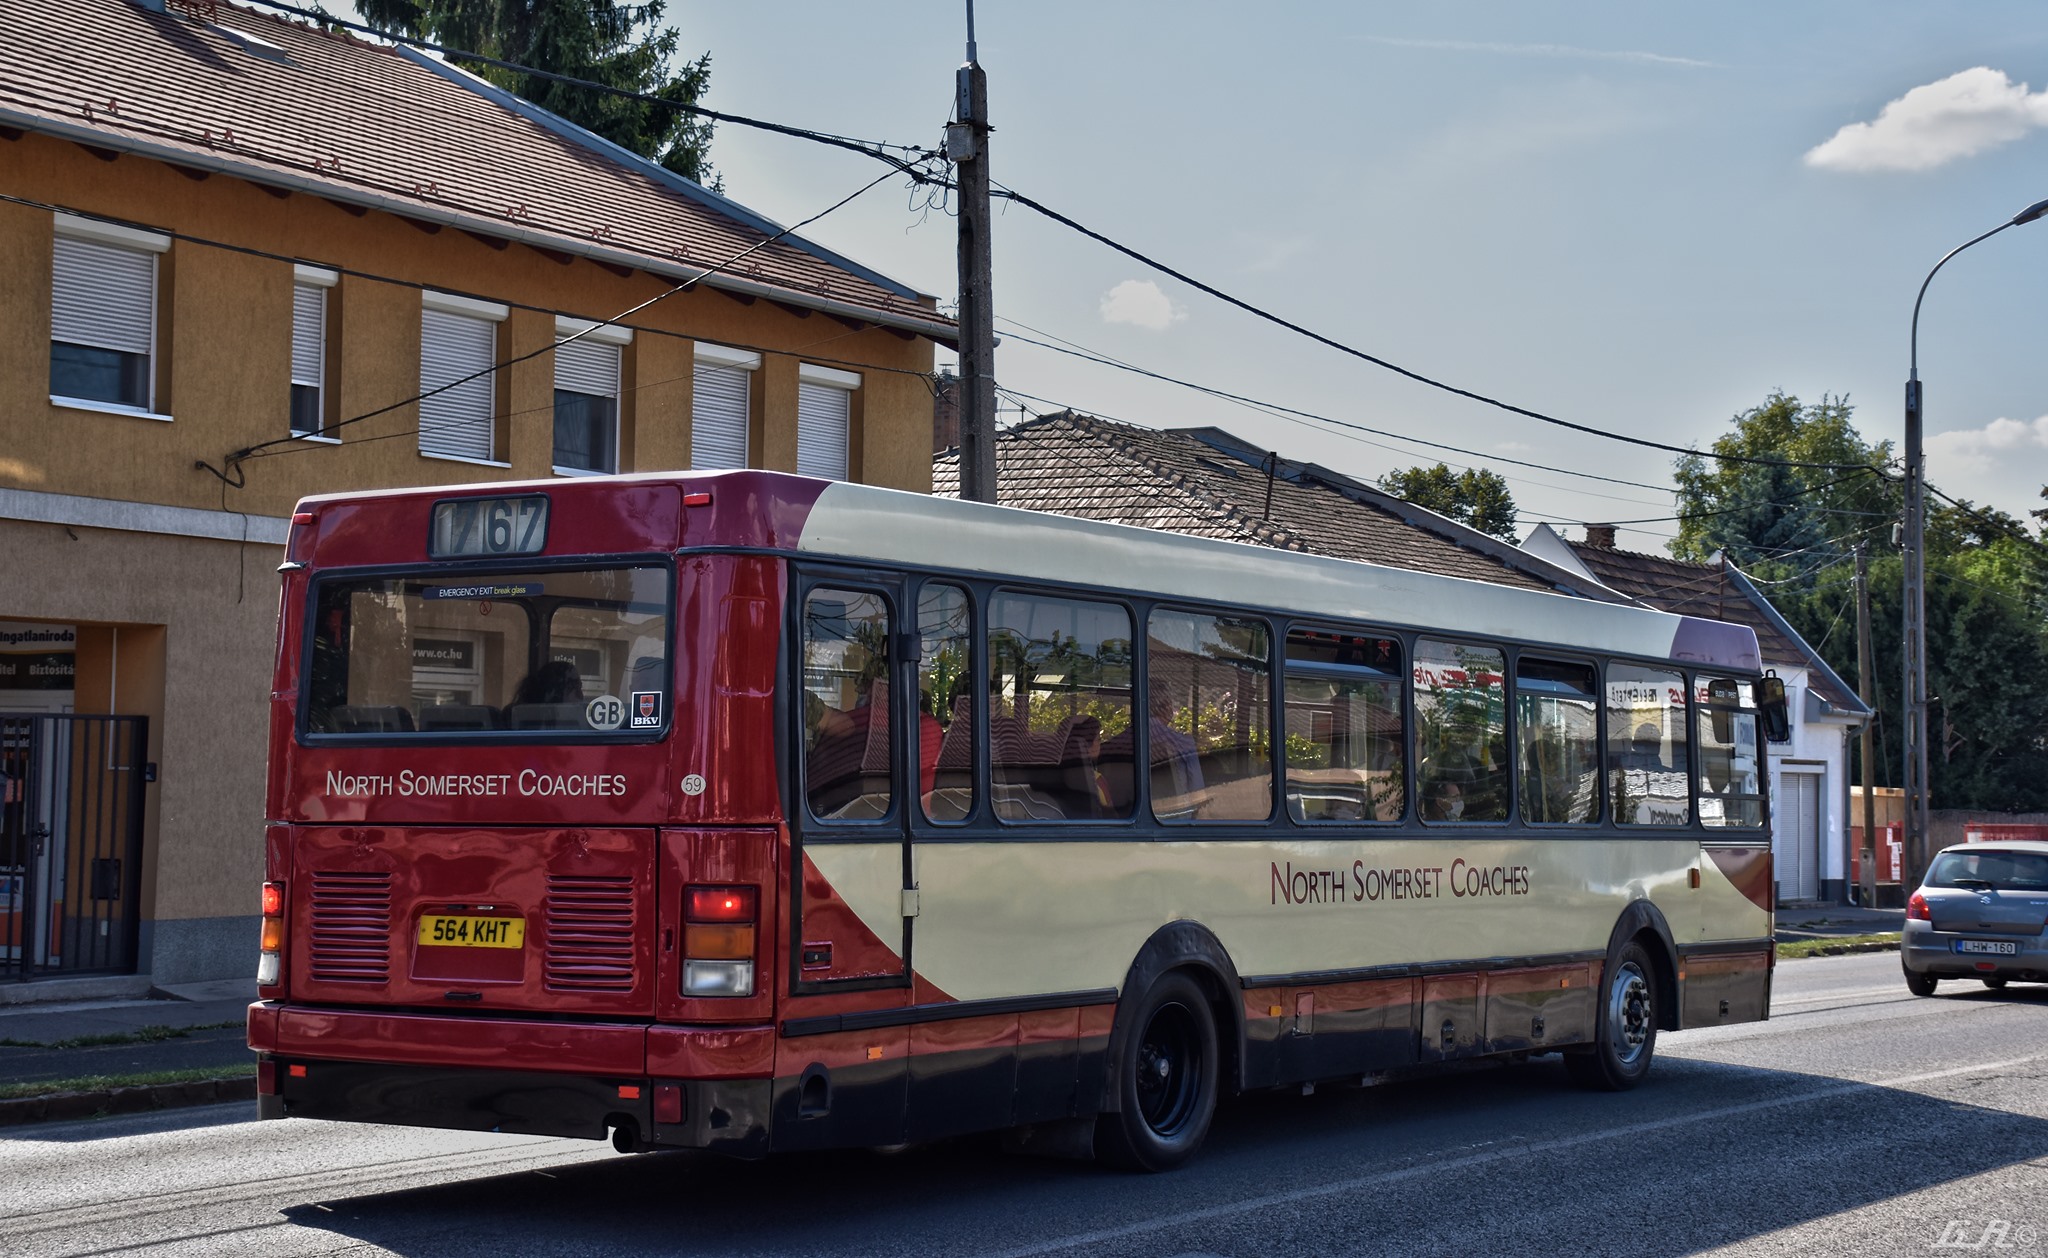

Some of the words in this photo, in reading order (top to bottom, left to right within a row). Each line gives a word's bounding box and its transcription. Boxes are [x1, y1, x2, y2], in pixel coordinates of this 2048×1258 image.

[439, 587, 479, 598] EMERGENCY
[479, 586, 494, 596] EXIT
[494, 586, 511, 595] break
[511, 585, 526, 596] glass
[29, 664, 77, 675] Biztosítá
[590, 701, 620, 725] GB
[634, 716, 659, 725] BKV
[685, 777, 702, 792] 59
[433, 919, 468, 942] 564
[473, 920, 511, 943] KHT
[1964, 942, 2013, 953] LHW-160
